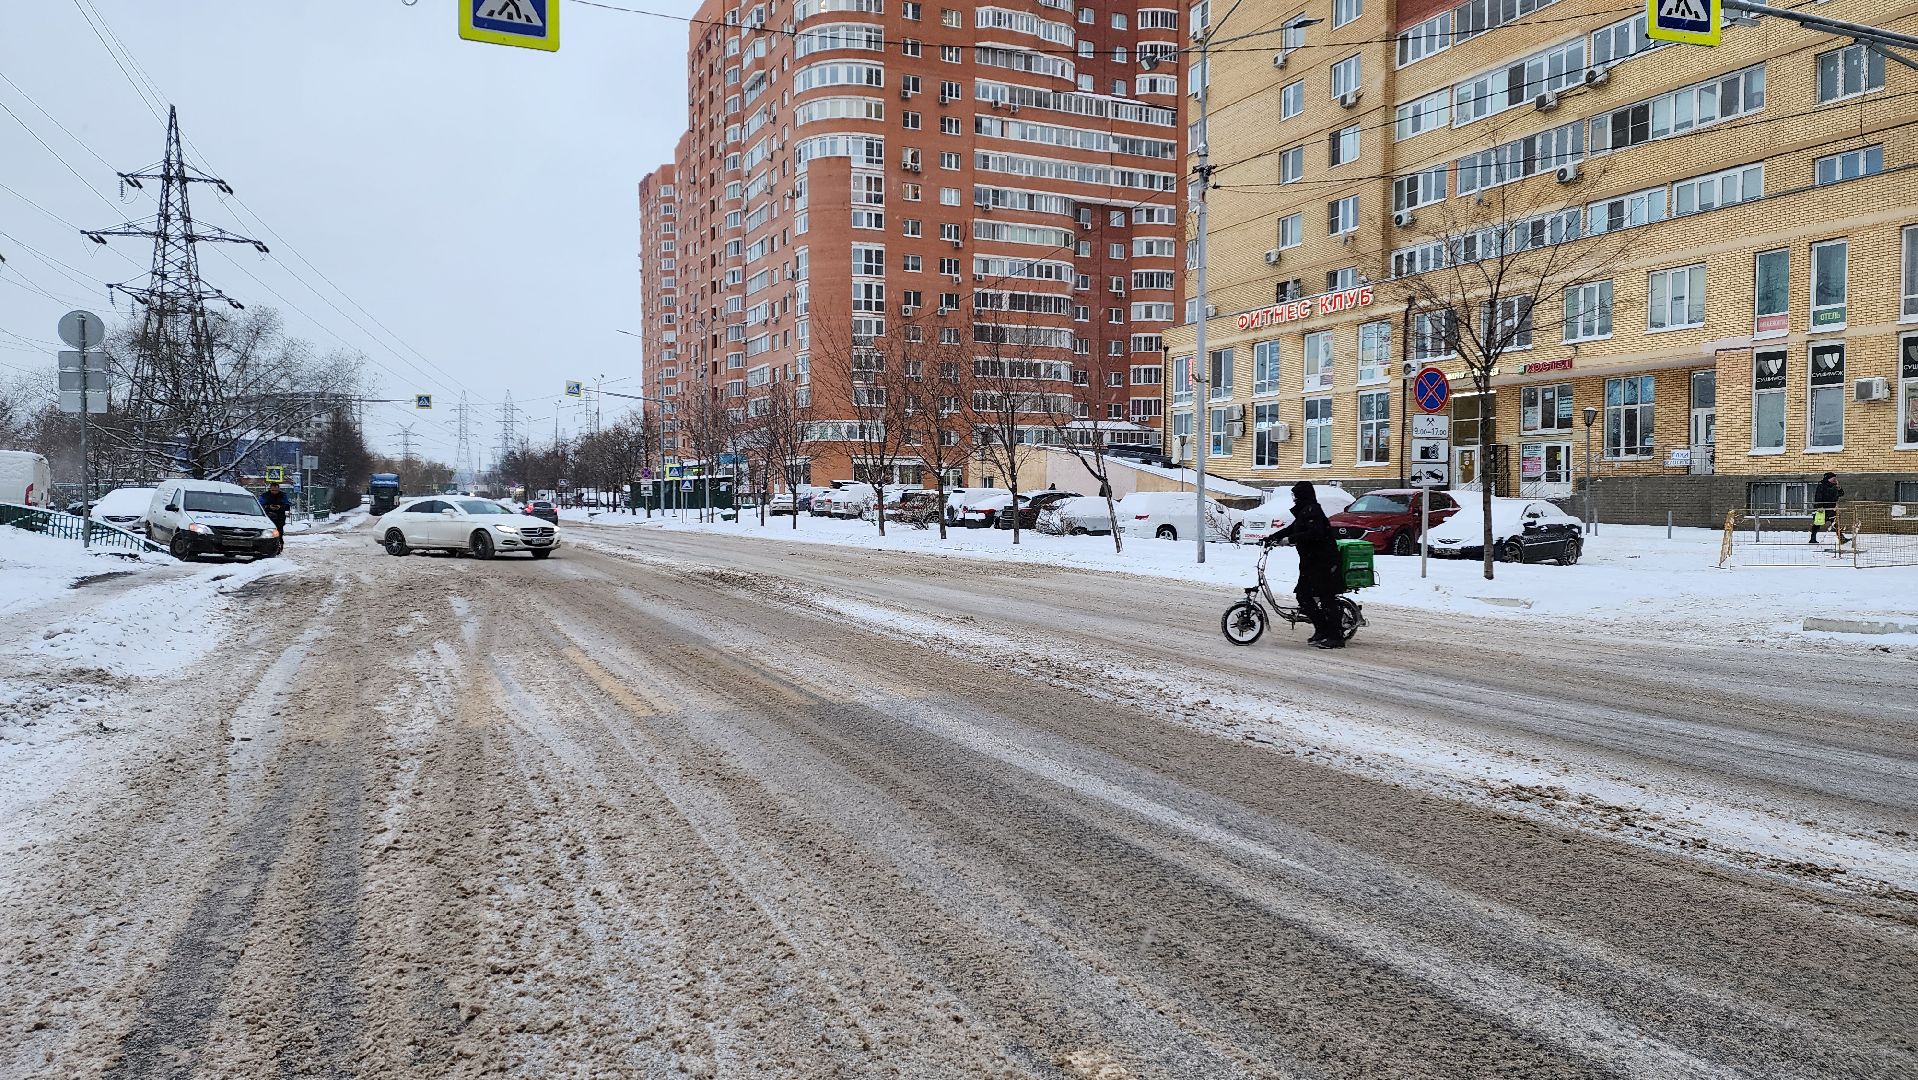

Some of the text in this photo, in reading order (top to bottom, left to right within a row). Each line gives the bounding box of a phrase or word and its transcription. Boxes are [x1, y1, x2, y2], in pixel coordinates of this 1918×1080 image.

[1237, 285, 1375, 330] ФИТНЕС КЛУБ
[1820, 311, 1841, 321] ОТЕЛЬ
[1527, 357, 1573, 374] ХОСТЕЛ
